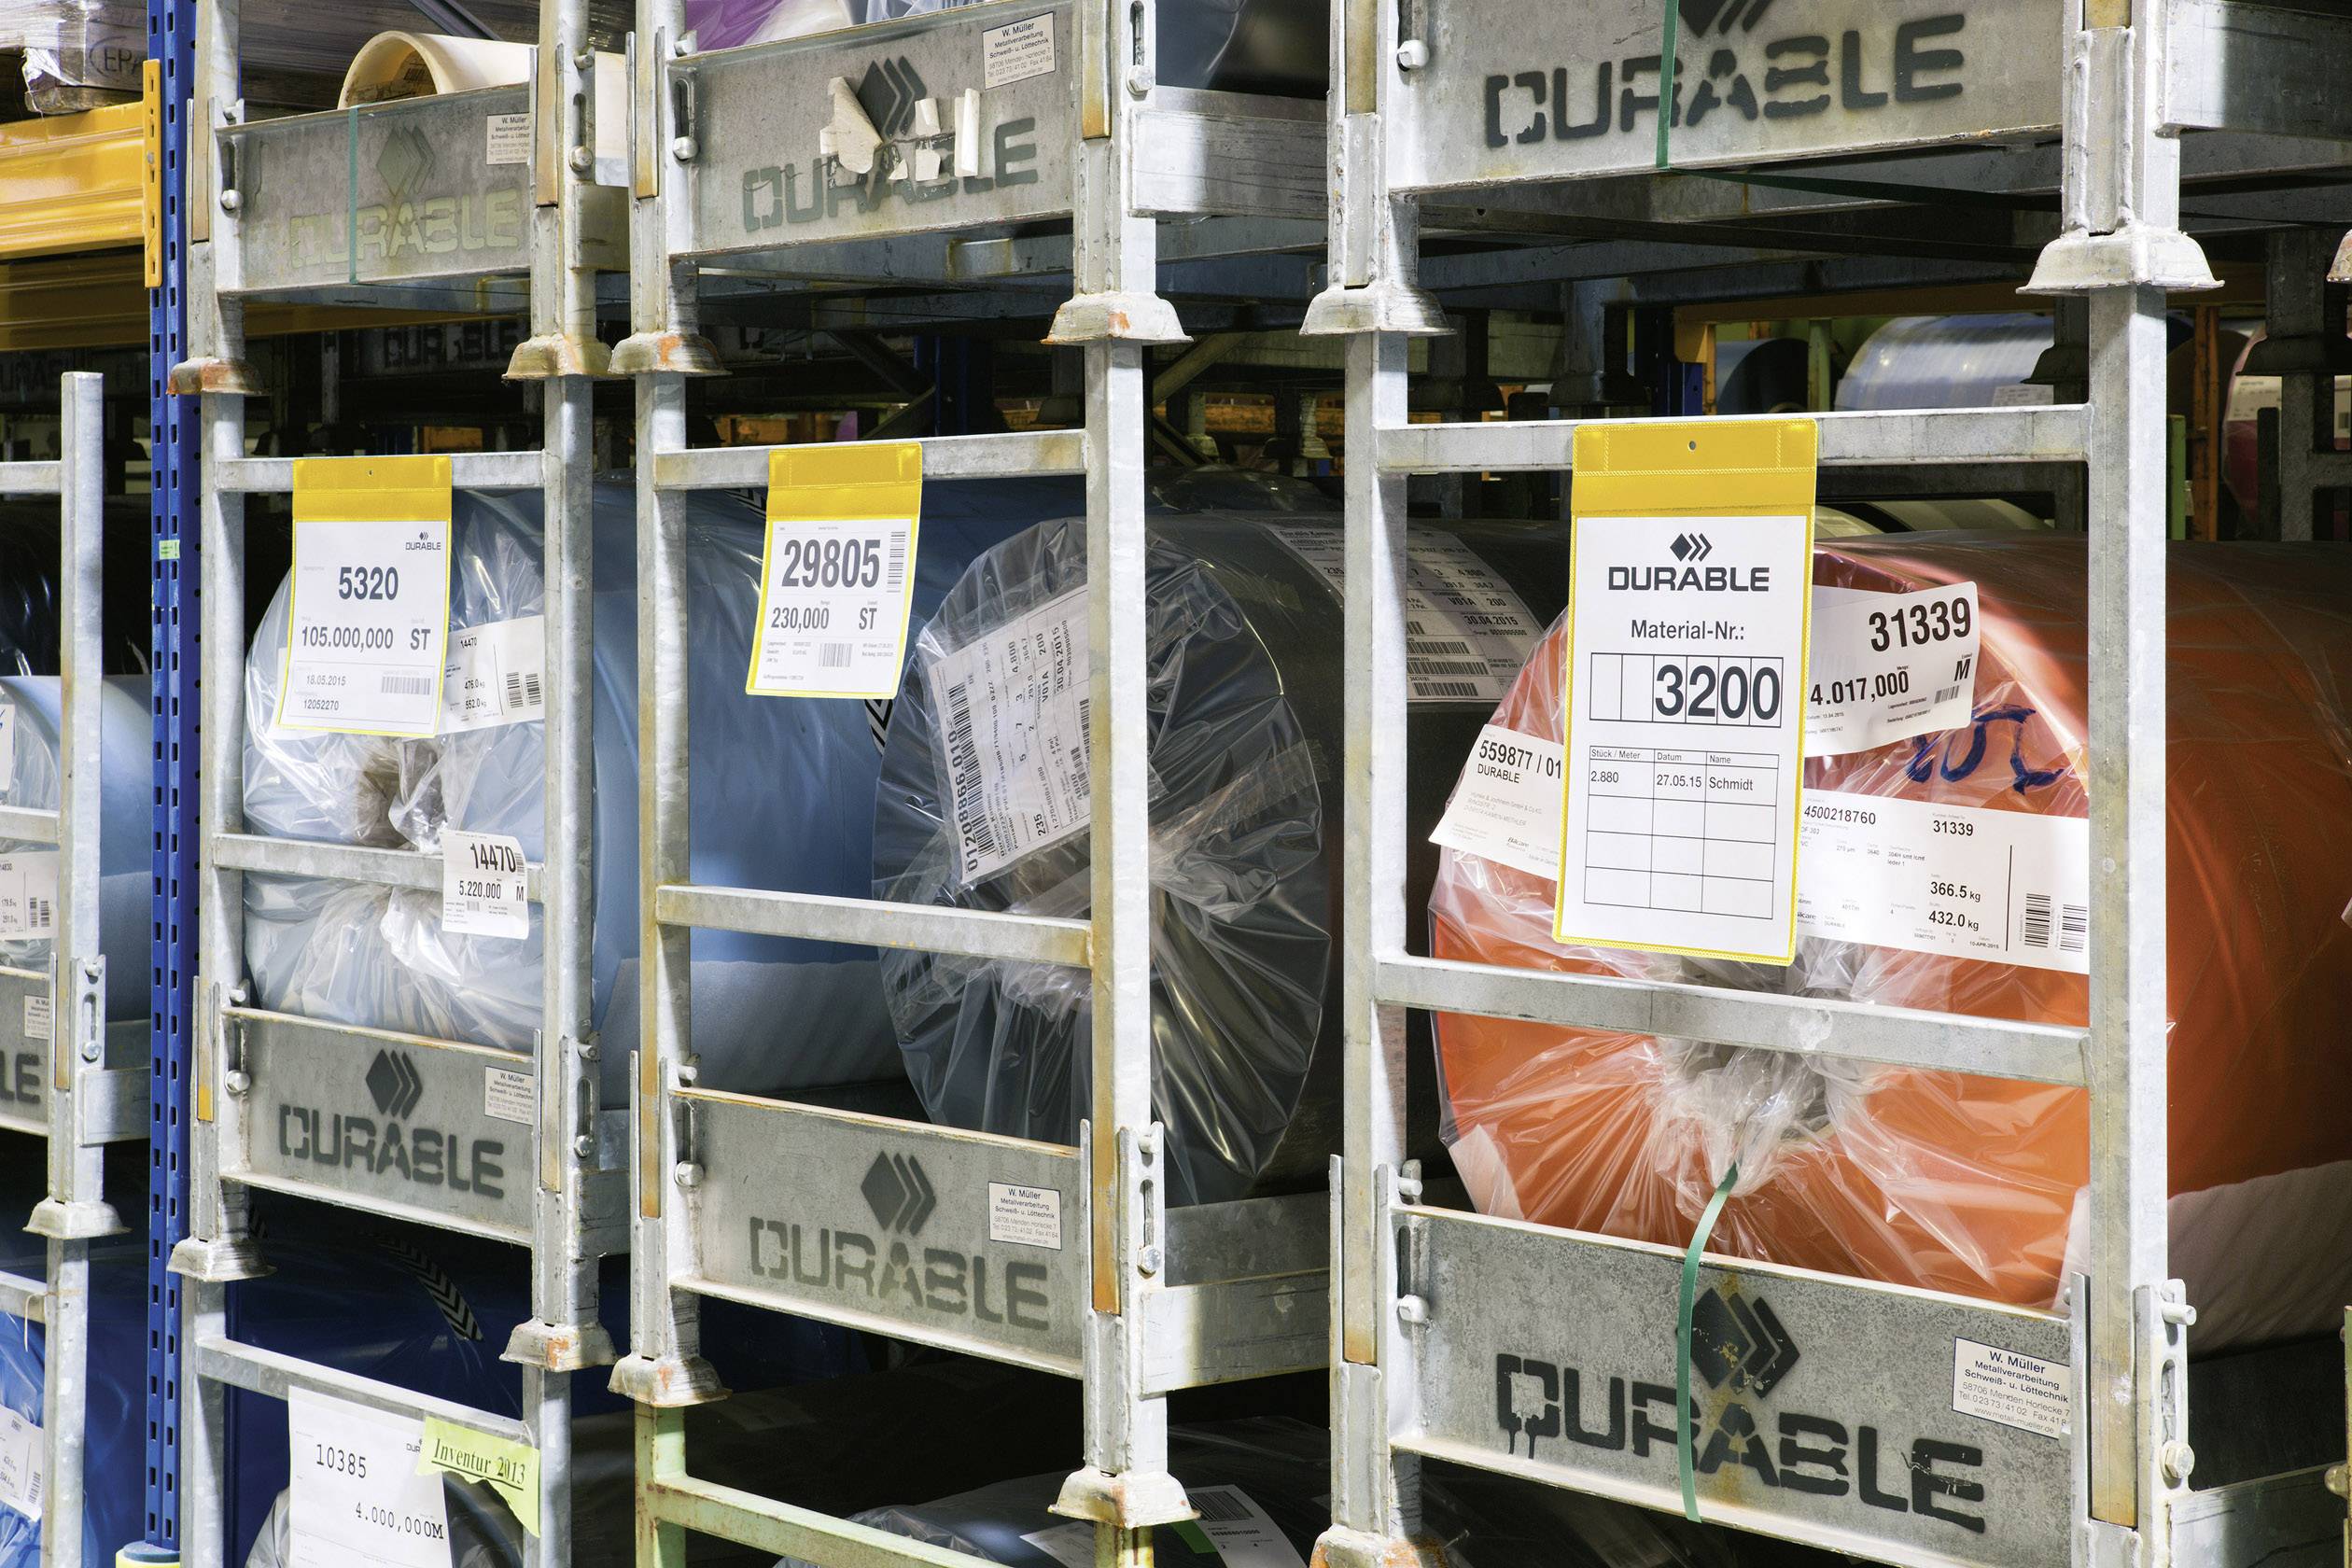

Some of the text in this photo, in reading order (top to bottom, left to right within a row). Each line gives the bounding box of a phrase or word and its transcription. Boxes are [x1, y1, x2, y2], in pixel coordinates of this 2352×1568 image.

[995, 31, 1043, 48] Metallverarbeitung
[1013, 23, 1034, 34] Müller
[1486, 13, 1965, 148] DURABLE
[290, 188, 519, 269] DURABLE
[782, 539, 881, 588] 29805
[339, 567, 399, 600] 5320
[1609, 567, 1770, 592] DURABLE
[771, 608, 877, 634] 230,000 ST
[1464, 616, 1519, 624] 30.04.2015
[1631, 620, 1743, 640] Material-Nr.:
[1869, 597, 1970, 651] 31339
[302, 626, 430, 652] 105.000,000 ST
[461, 637, 477, 648] 14470
[1036, 633, 1046, 655] 200
[1008, 641, 1018, 672] 4.800
[1052, 627, 1064, 692] 30.04.2015
[1656, 665, 1780, 720] 3200
[1811, 659, 1970, 705] 4.017,000 M
[304, 699, 339, 710] 12052270
[1479, 740, 1561, 778] 559877 / 01
[1591, 749, 1612, 758] Stück
[1619, 750, 1641, 760] Meter
[1657, 752, 1681, 762] Datum
[1710, 755, 1731, 763] Name
[1477, 763, 1519, 783] DURABLE
[1590, 771, 1753, 791] 2.880 27.05.15 Schmidt
[947, 732, 977, 872] 01208866.010
[1033, 814, 1045, 836] 235
[1804, 805, 1973, 836] 4500218760 31339
[470, 844, 516, 873] 14470
[516, 886, 524, 902] M
[1930, 881, 1981, 903] 366.5 kg
[1929, 911, 1979, 931] 432.0 kg
[280, 1104, 503, 1198] DURABLE
[1001, 1198, 1049, 1211] Metallverarbeitung
[1019, 1189, 1041, 1199] Müller
[995, 1206, 1019, 1214] Schweiß-
[1028, 1211, 1055, 1219] Löttechnik
[750, 1216, 1049, 1331] DURABLE
[1990, 1351, 2045, 1373] W. Müller
[1965, 1369, 2007, 1386] Schweiß-
[2021, 1384, 2068, 1403] Löttechnik
[1975, 1361, 2059, 1391] Metallverarbeitung
[1963, 1382, 1987, 1395] 58706
[1990, 1388, 2023, 1405] Menden
[2033, 1411, 2048, 1421] Fax
[1496, 1352, 1986, 1534] DURABLE
[316, 1444, 366, 1478] 10385
[434, 1438, 525, 1486] Inventur 2013
